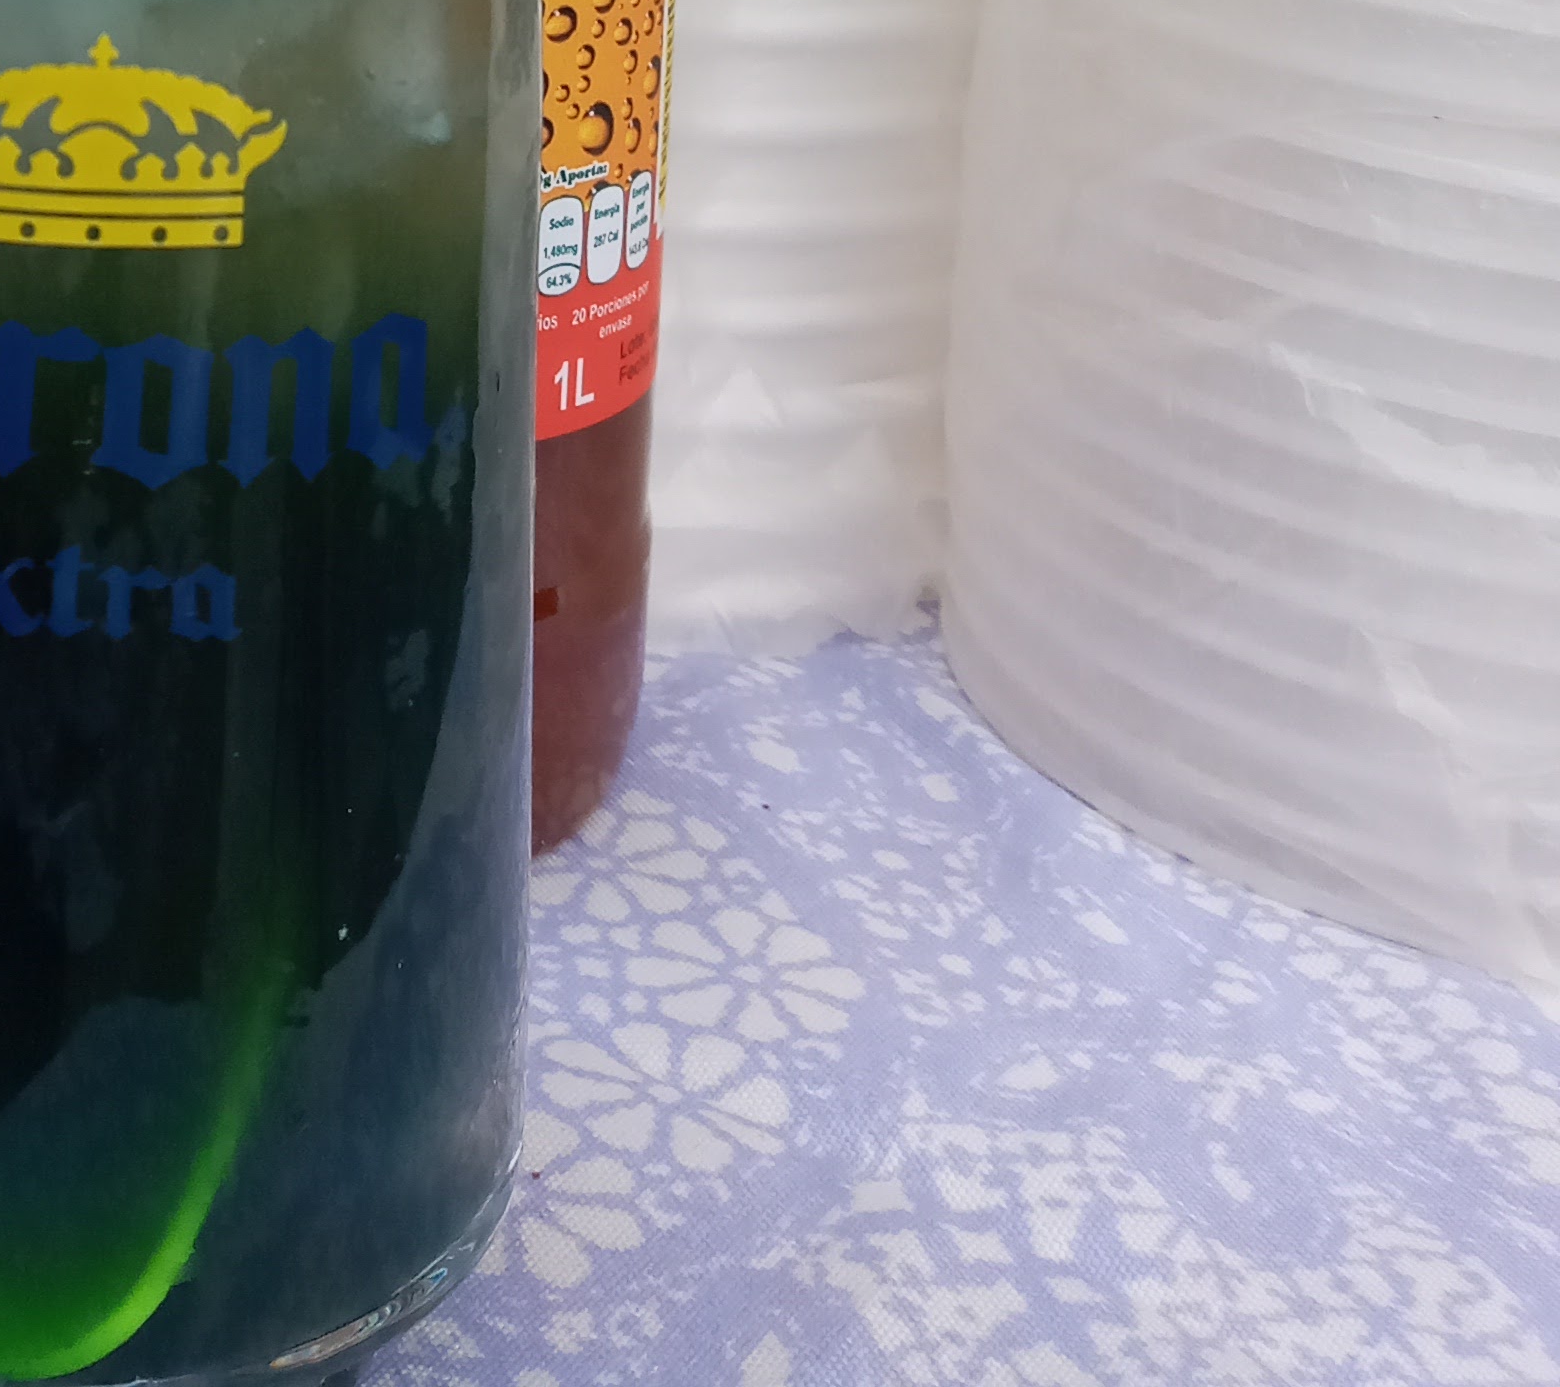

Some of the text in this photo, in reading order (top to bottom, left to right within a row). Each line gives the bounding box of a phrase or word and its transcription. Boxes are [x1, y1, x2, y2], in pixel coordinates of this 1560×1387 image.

[549, 215, 575, 230] Sodio
[571, 306, 587, 326] 20
[589, 288, 637, 321] Porciones
[598, 313, 633, 339] envase
[553, 356, 596, 412] 1L
